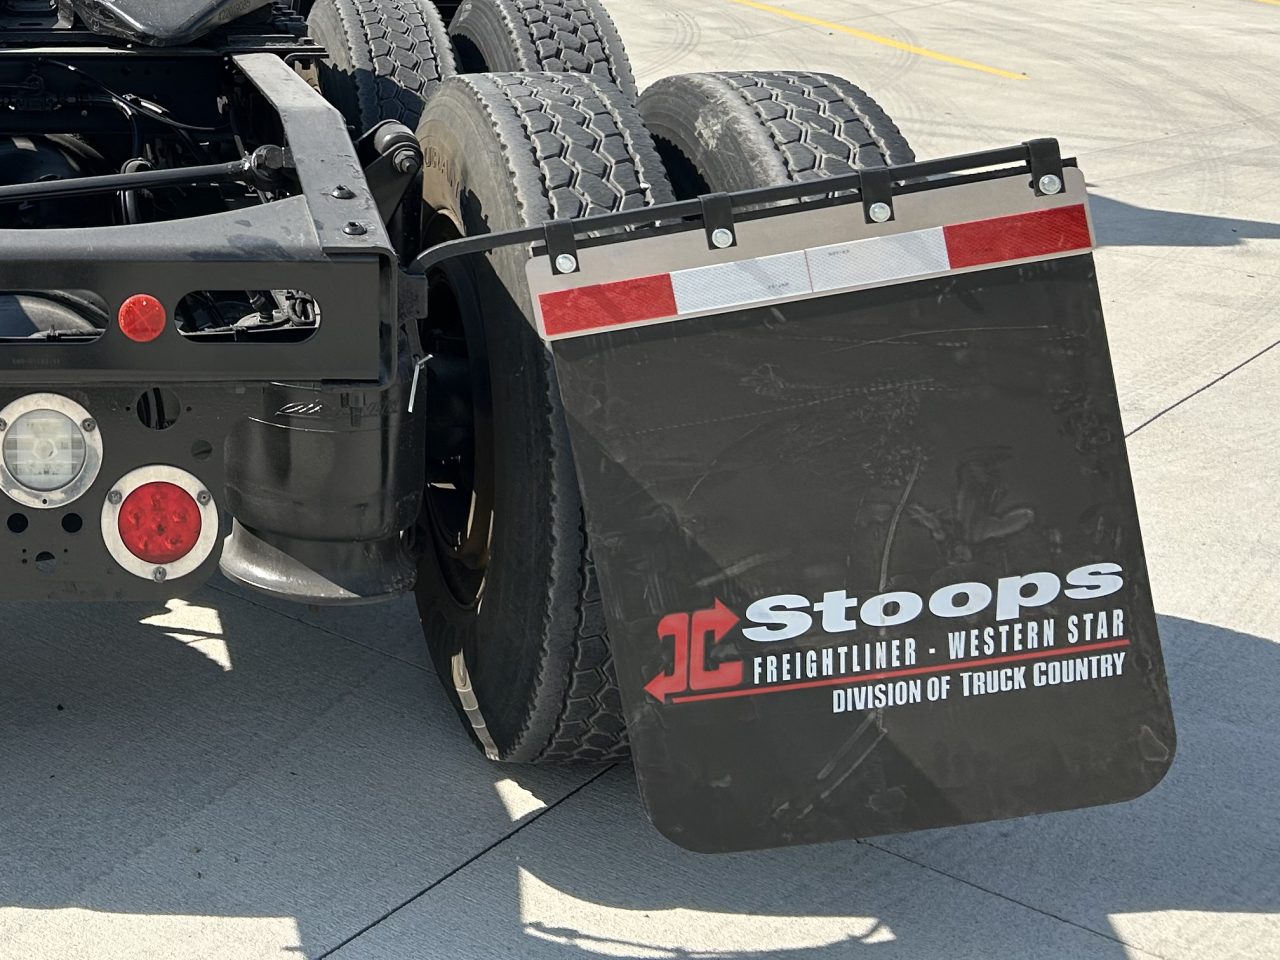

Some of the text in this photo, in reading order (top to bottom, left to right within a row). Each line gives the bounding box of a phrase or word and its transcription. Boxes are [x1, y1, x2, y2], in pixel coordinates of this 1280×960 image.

[741, 562, 1124, 642] Stoops
[753, 637, 916, 685] FREIGHTLINER
[947, 618, 1055, 660] WESTERN
[1067, 608, 1124, 644] STAR
[832, 651, 1126, 714] DIVISION OF TRUCK COUNTRY
